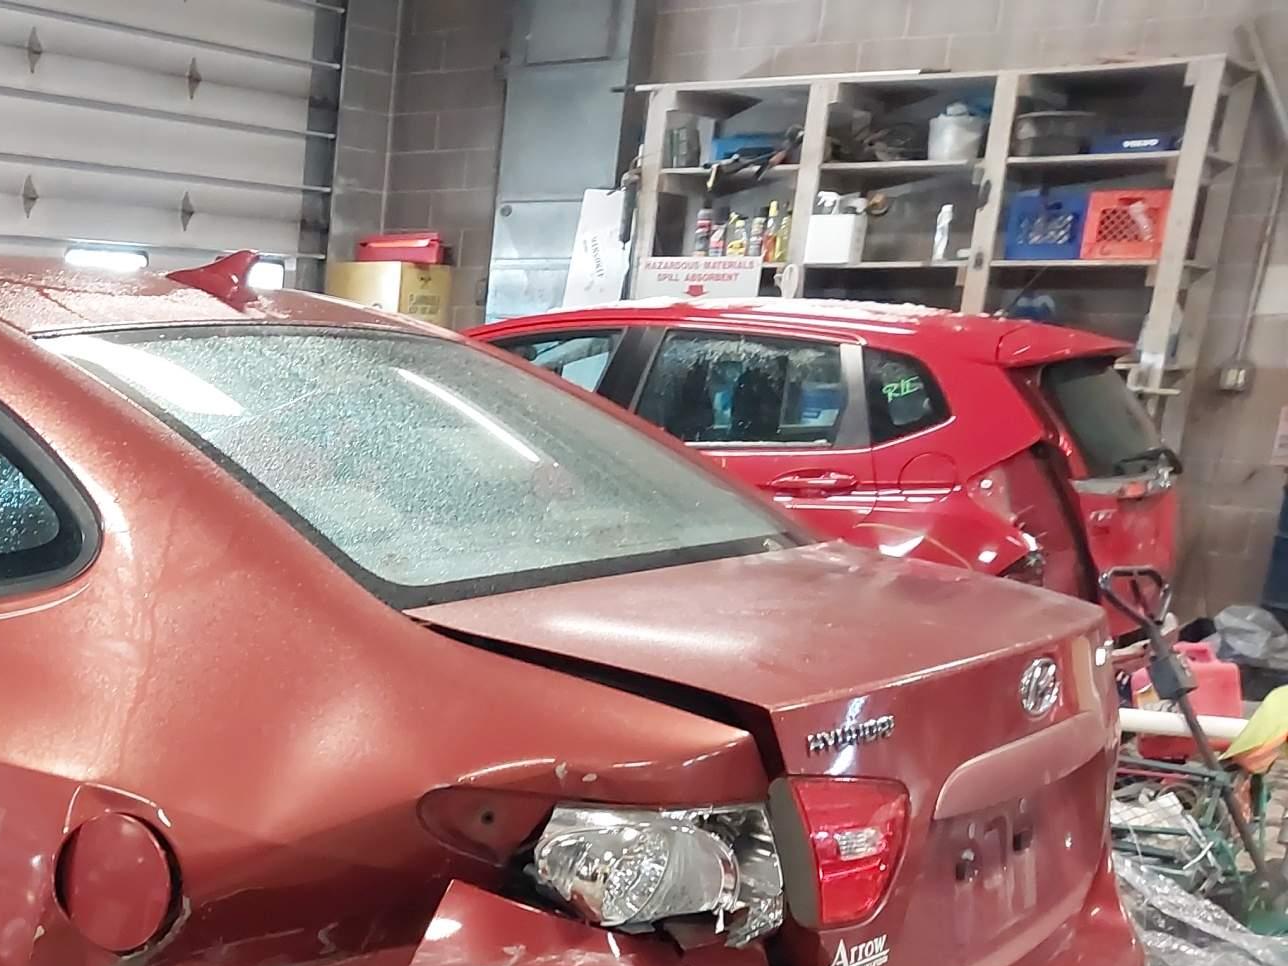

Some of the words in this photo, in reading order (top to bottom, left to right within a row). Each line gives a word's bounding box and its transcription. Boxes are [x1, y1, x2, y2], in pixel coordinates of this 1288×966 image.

[646, 260, 700, 270] HAZARDOUS
[704, 259, 755, 270] MATERIALS
[685, 272, 740, 282] ABSORBENT
